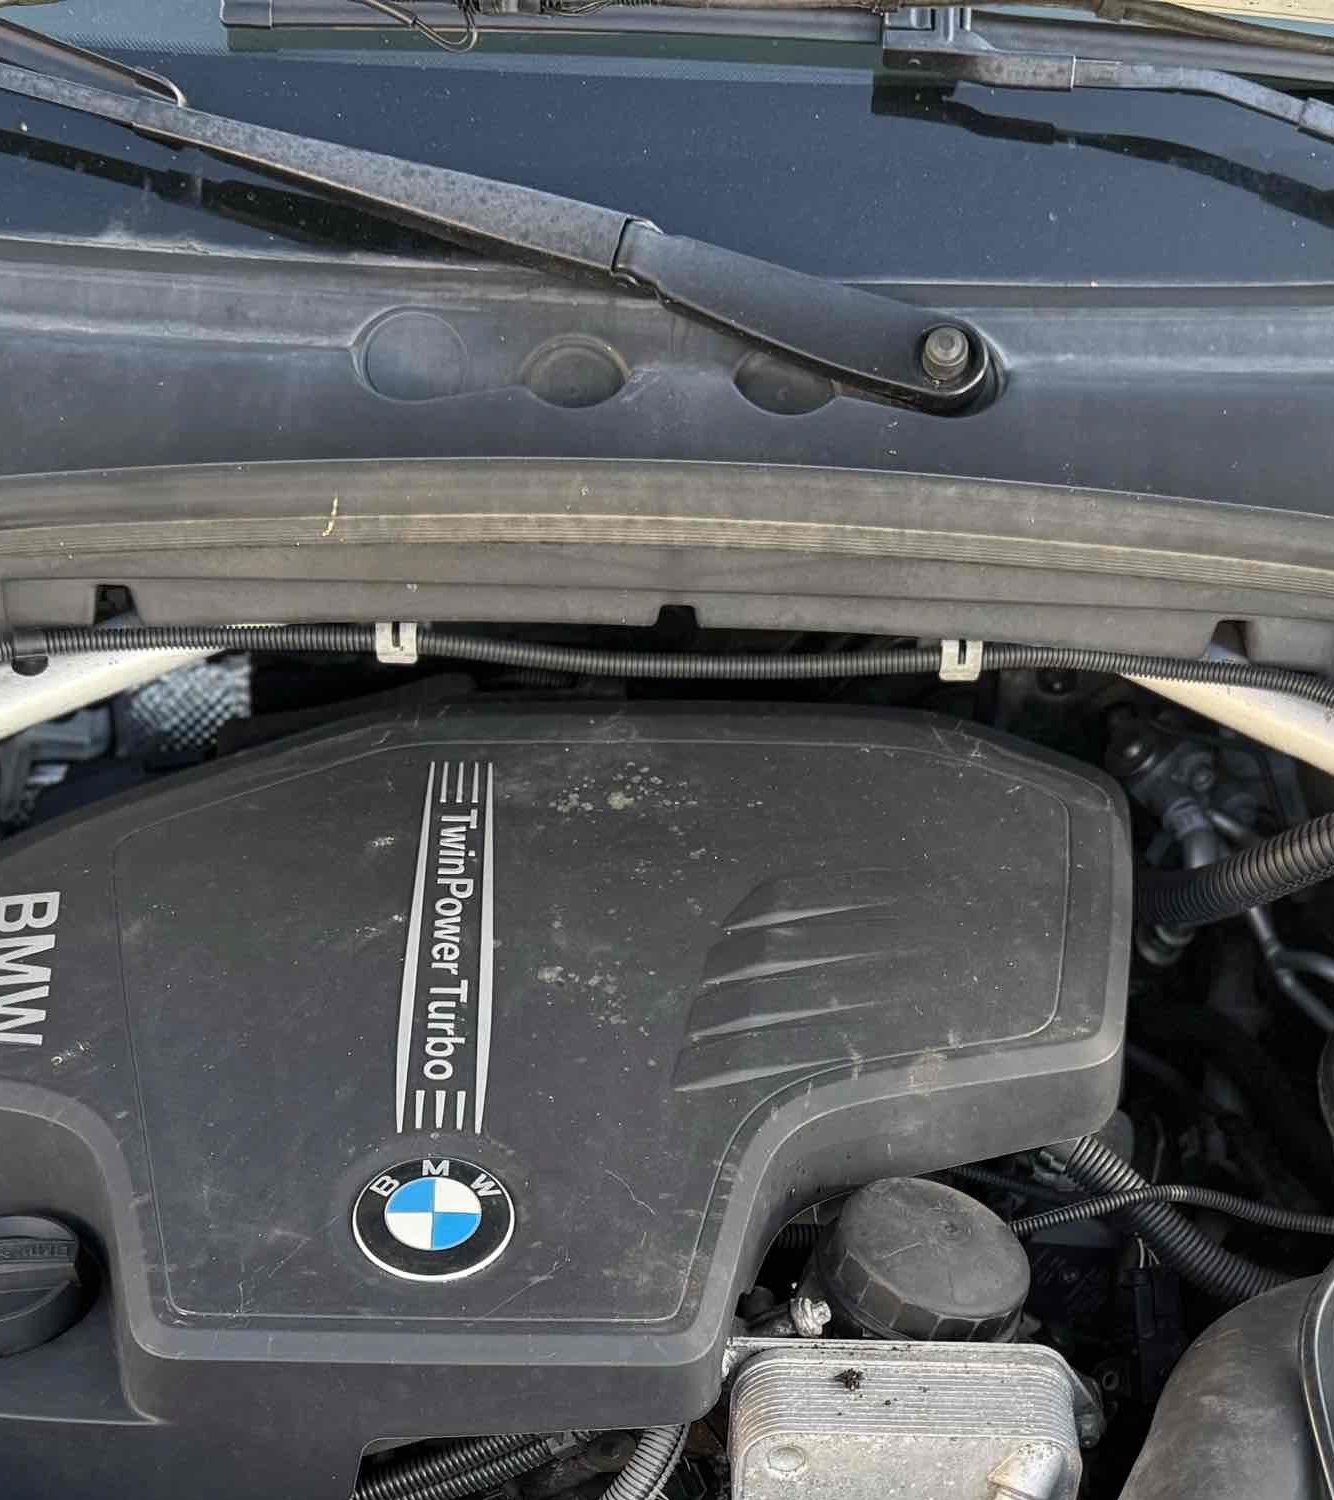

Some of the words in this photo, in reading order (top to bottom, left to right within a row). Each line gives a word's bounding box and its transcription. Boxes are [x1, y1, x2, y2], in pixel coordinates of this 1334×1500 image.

[431, 808, 479, 976] TwinPower
[423, 979, 469, 1081] Turbo
[369, 1159, 503, 1198] BMW
